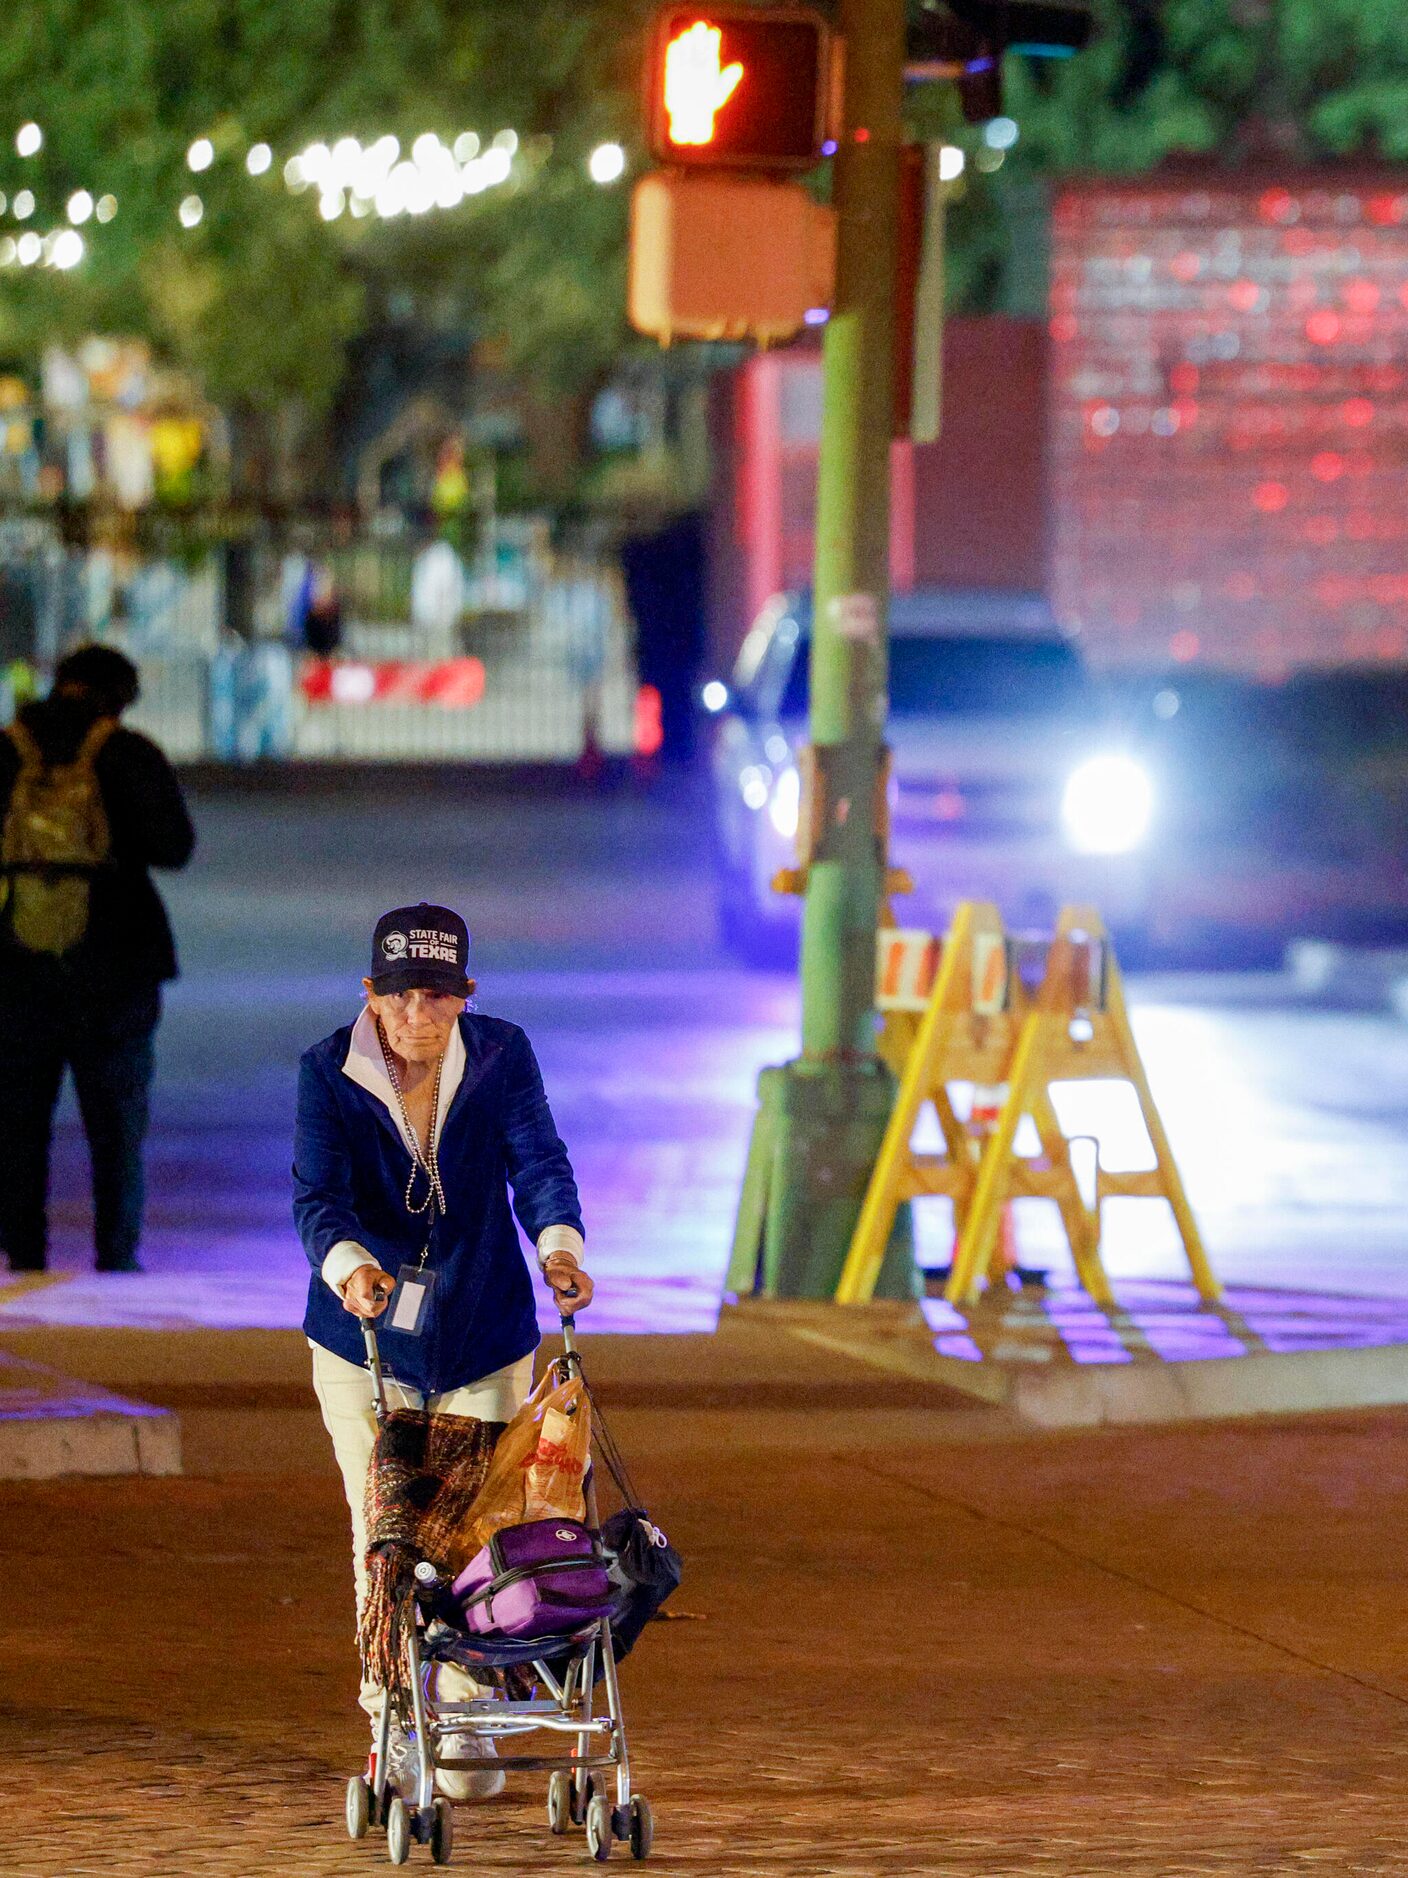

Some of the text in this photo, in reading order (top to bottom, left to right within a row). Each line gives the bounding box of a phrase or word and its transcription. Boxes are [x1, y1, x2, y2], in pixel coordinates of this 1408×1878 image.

[409, 929, 458, 944] STATE FAIR
[409, 944, 458, 964] TEXAS
